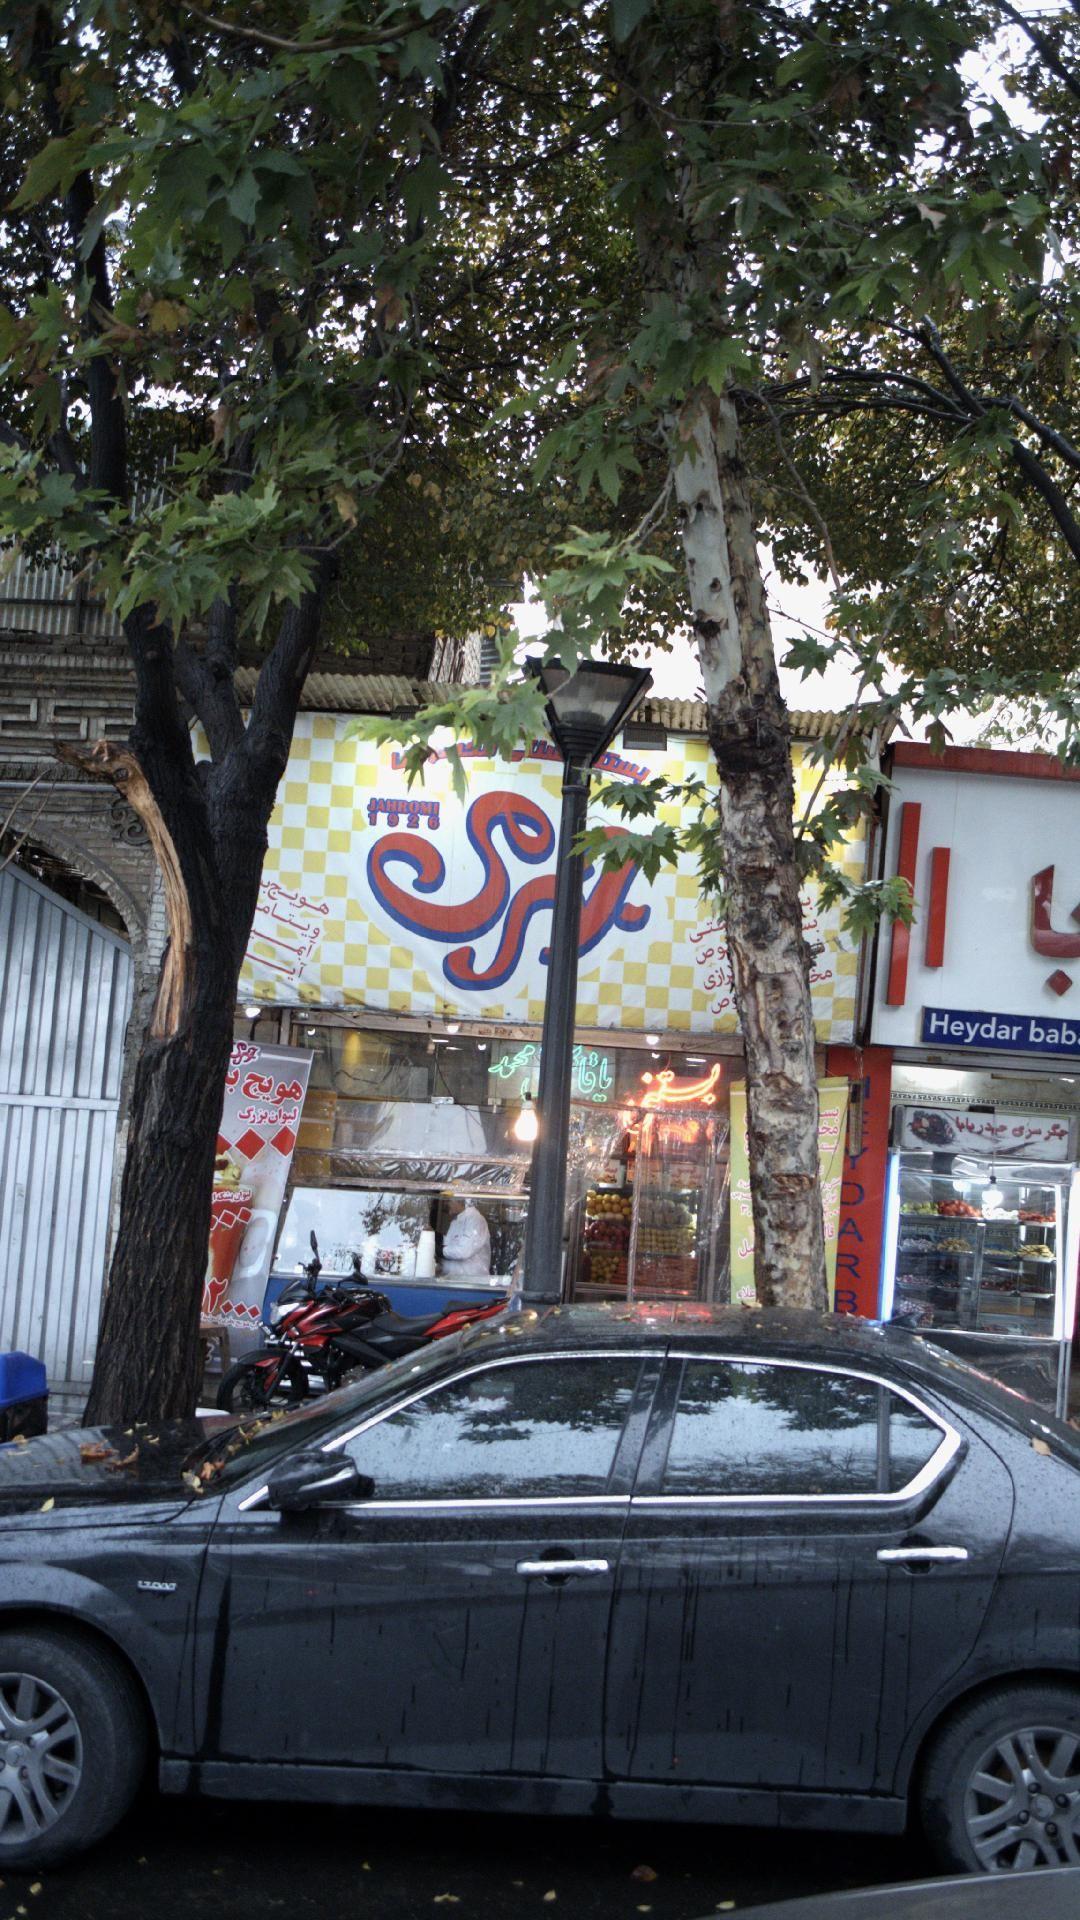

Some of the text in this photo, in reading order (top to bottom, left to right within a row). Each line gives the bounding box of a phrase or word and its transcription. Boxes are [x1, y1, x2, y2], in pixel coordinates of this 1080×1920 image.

[367, 797, 440, 815] JAHROMI
[367, 812, 440, 831] 1926
[929, 1012, 1022, 1043] Heydar
[242, 1072, 303, 1106] هویج
